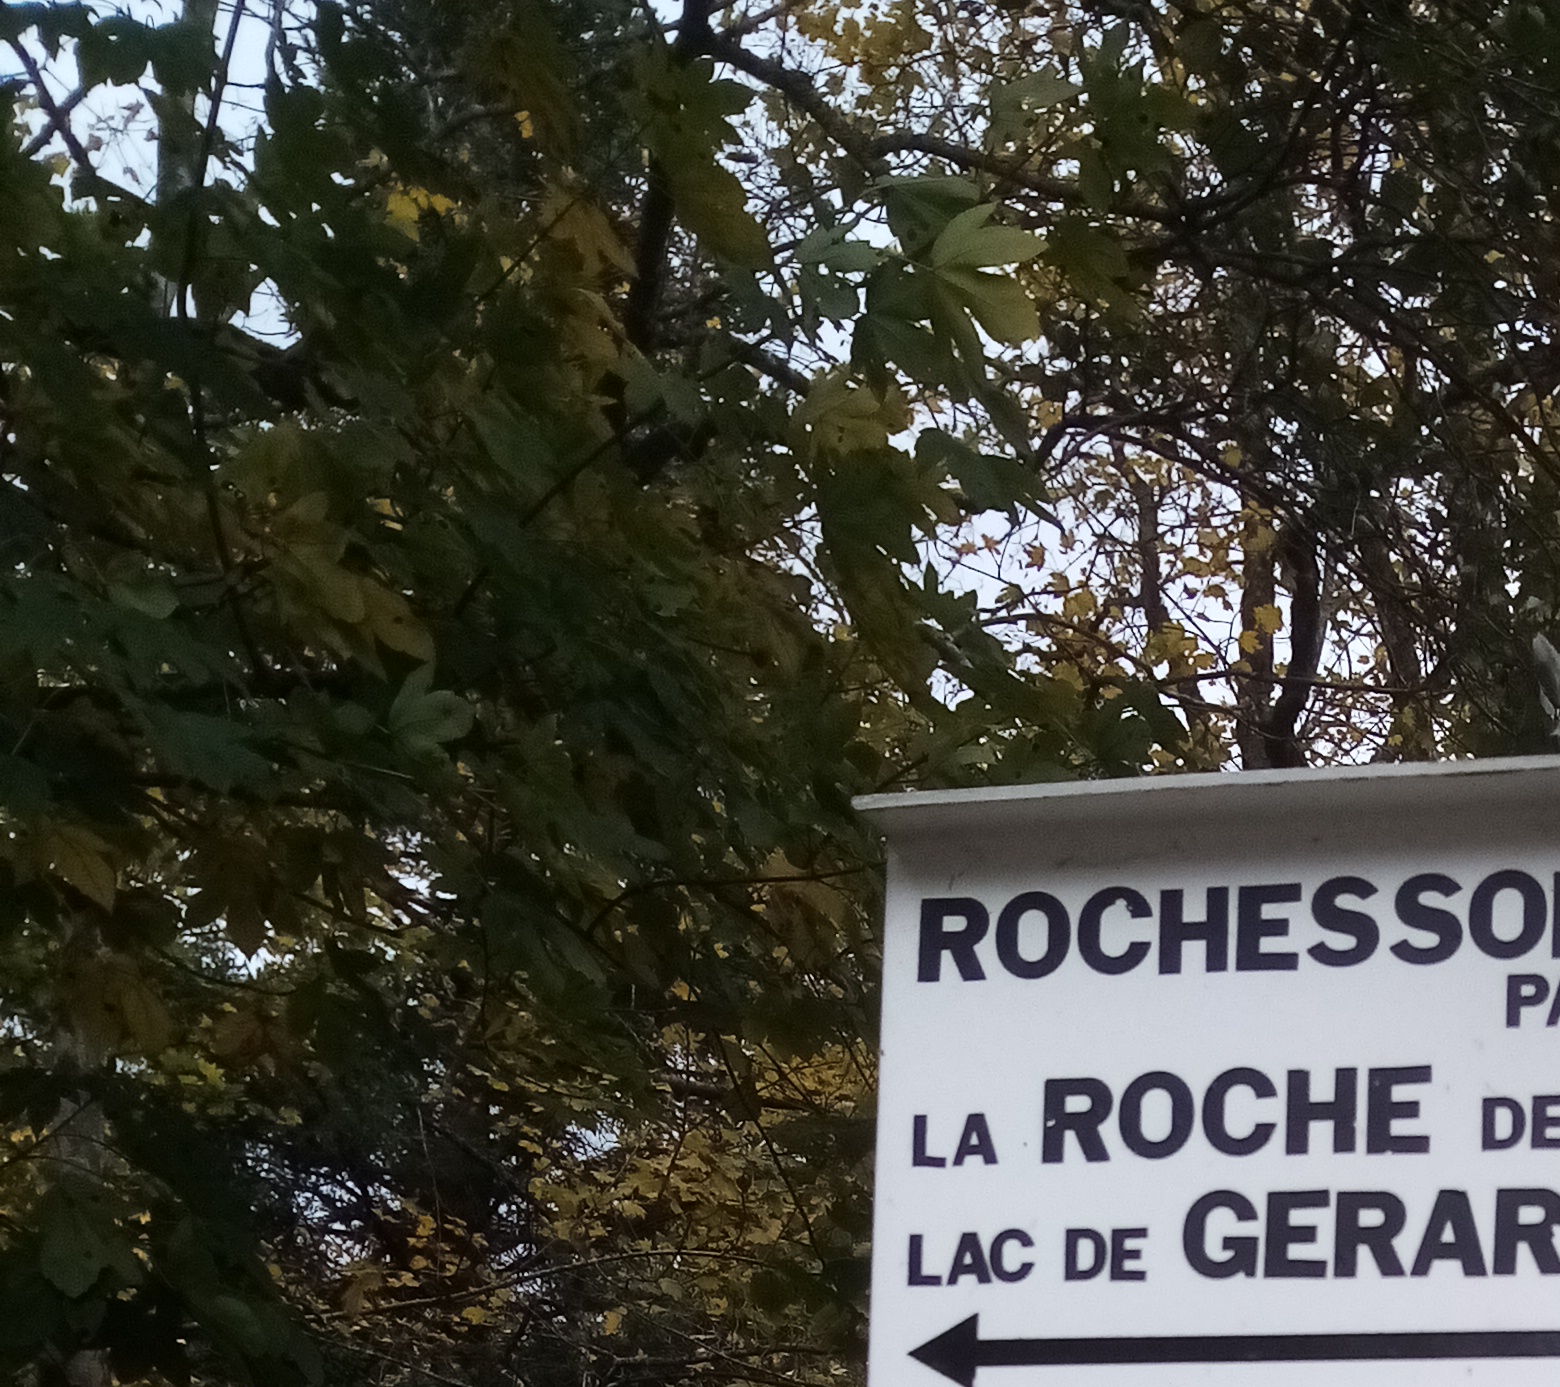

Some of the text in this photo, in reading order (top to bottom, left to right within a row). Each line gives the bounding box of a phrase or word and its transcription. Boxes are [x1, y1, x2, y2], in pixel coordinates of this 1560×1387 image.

[911, 1112, 999, 1169] LA
[1040, 1063, 1432, 1165] ROCHE
[906, 1227, 1036, 1288] LAC
[1063, 1226, 1149, 1283] DE
